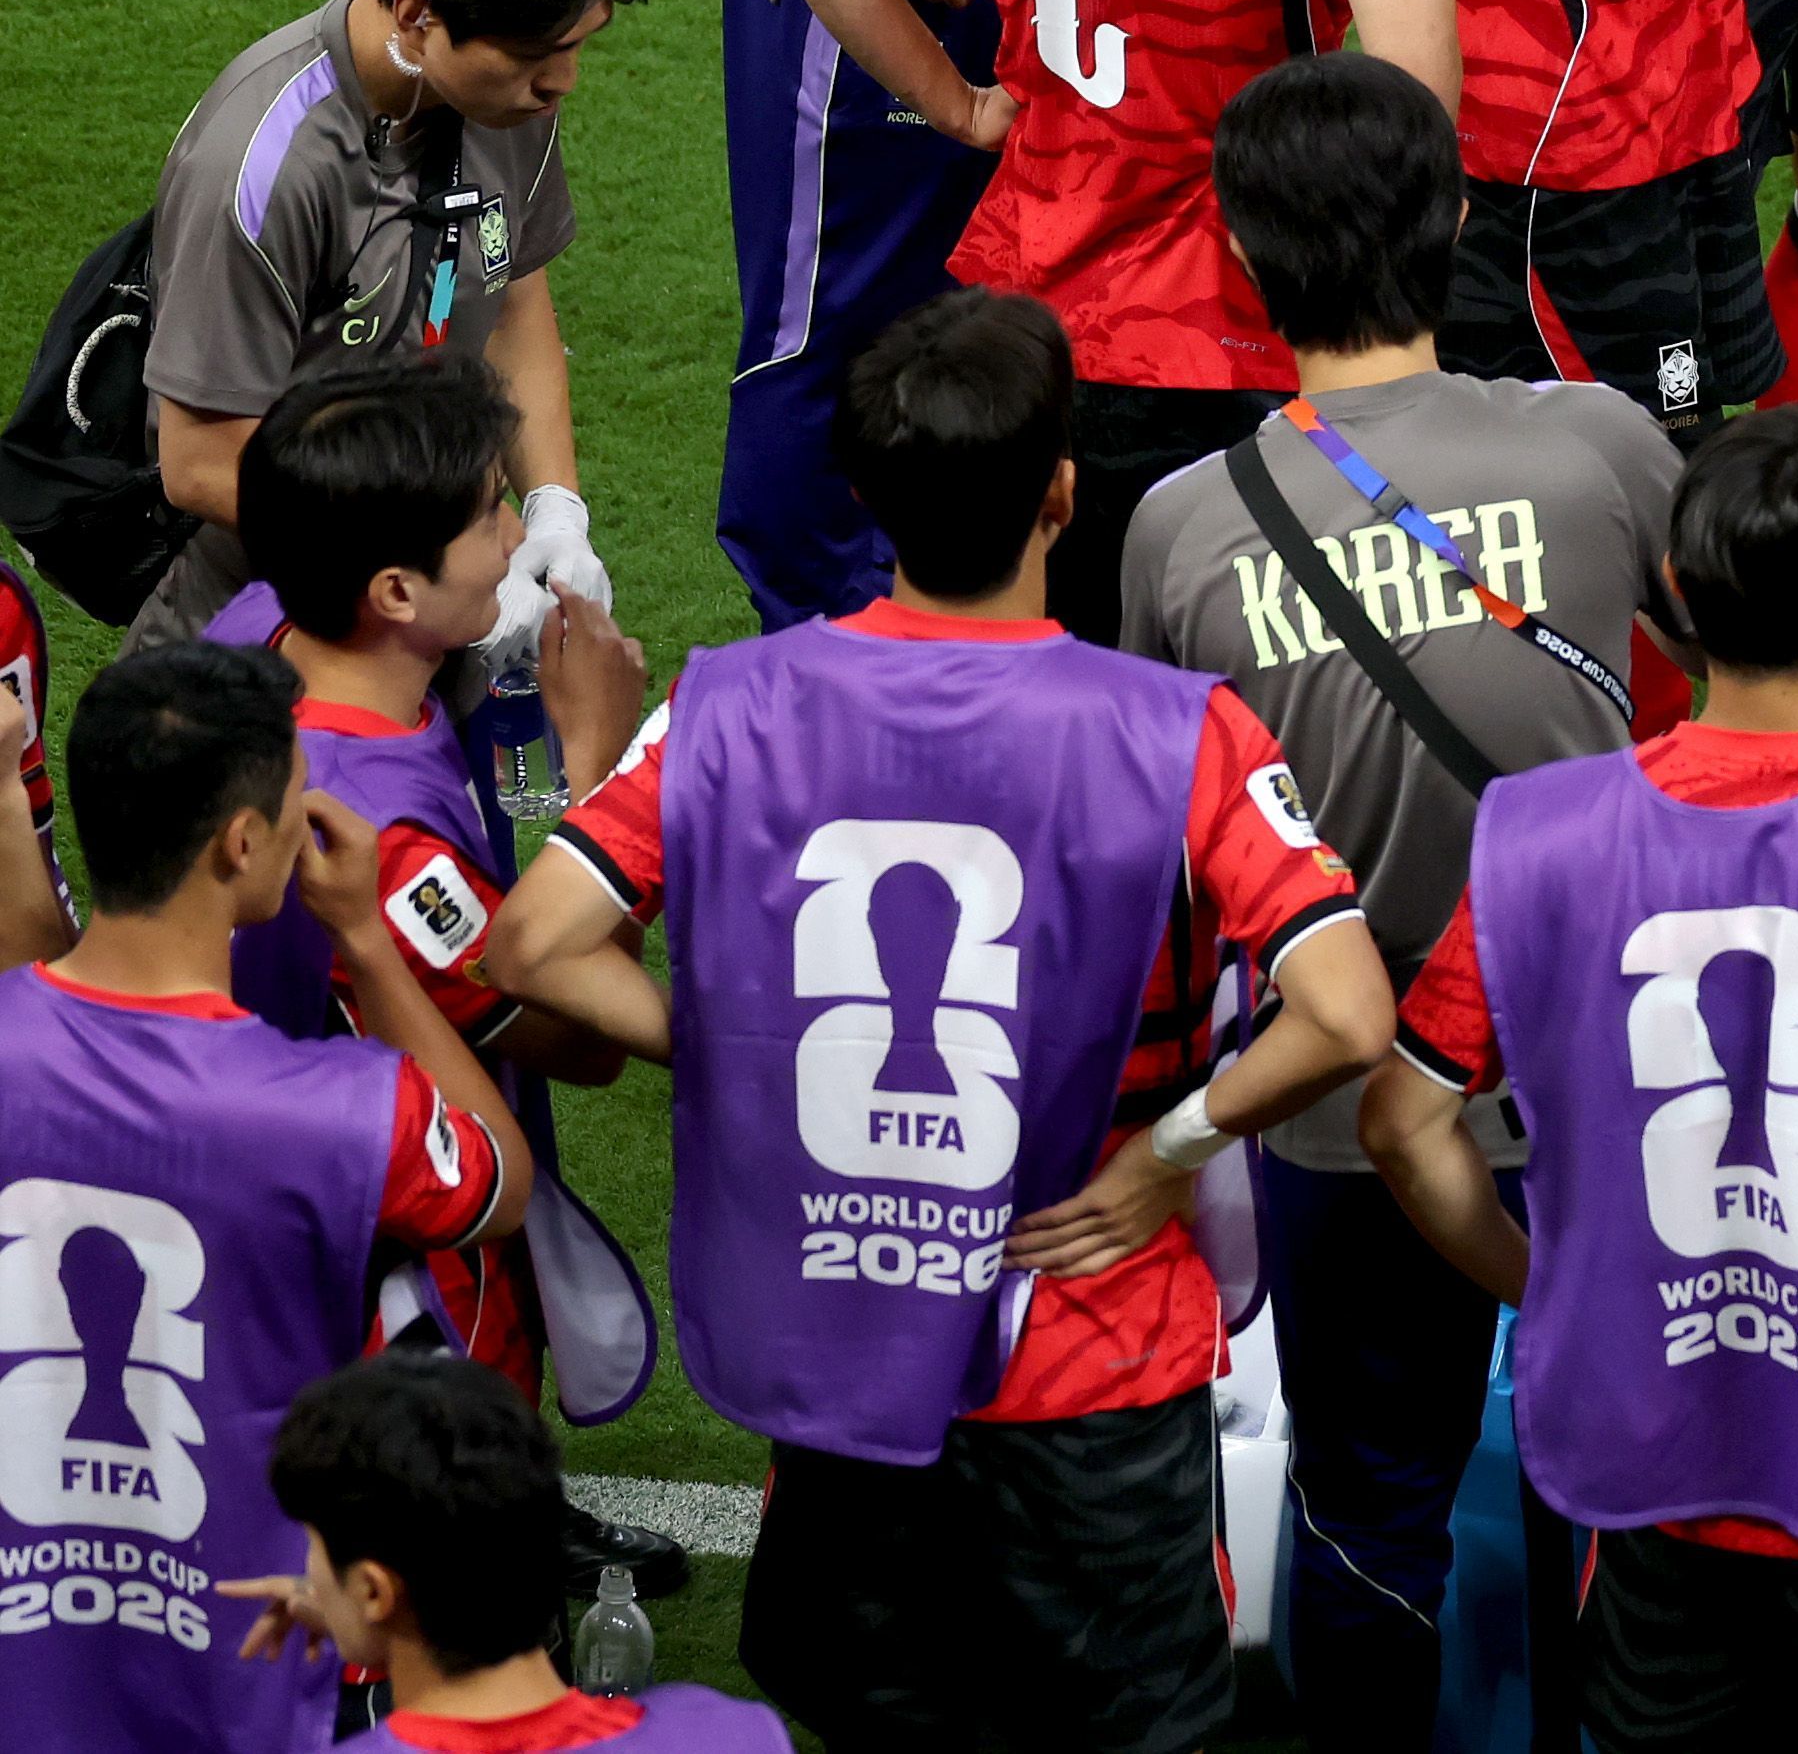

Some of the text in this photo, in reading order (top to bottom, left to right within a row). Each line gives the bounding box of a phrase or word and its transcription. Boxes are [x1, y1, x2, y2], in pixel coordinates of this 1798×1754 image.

[341, 315, 380, 346] CJ
[1232, 498, 1549, 670] KOREA
[1534, 628, 1584, 667] 2026
[1581, 659, 1605, 683] CUP
[869, 1110, 965, 1153] FIFA
[801, 1193, 1013, 1239] WORLD CUP
[1715, 1184, 1788, 1234] FIFA
[801, 1231, 1006, 1295] 2026
[1658, 1266, 1779, 1311] WORLD
[61, 1458, 161, 1502] FIFA
[0, 1539, 209, 1596] WORLD CUP
[0, 1575, 211, 1652] 2026
